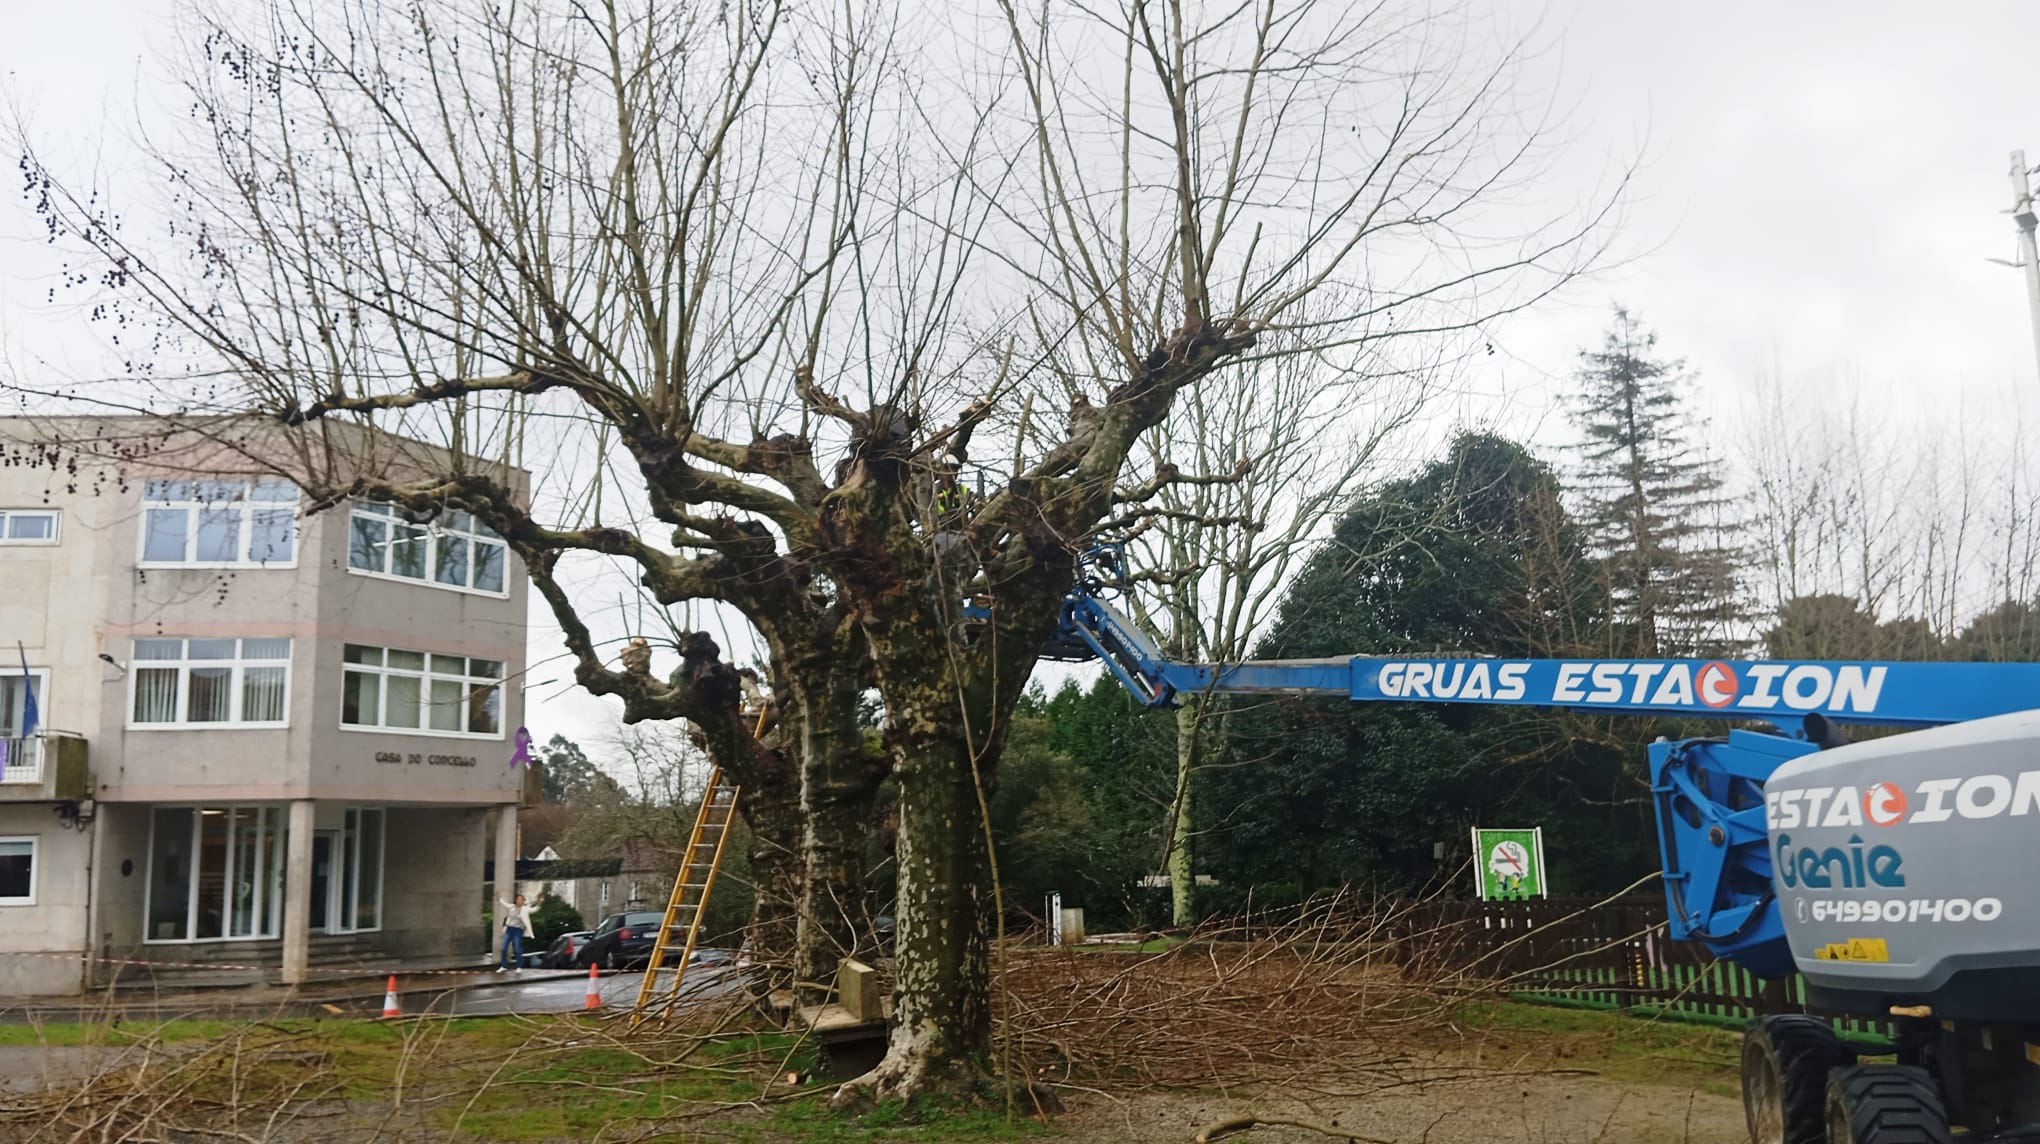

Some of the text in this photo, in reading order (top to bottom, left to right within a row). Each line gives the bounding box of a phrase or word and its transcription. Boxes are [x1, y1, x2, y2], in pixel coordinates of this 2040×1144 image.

[1378, 661, 1888, 713] GRUAS ESTACION
[375, 751, 402, 763] CASA
[408, 753, 422, 765] DO
[1776, 833, 1906, 889] Genie
[1812, 897, 2002, 923] 649901400
